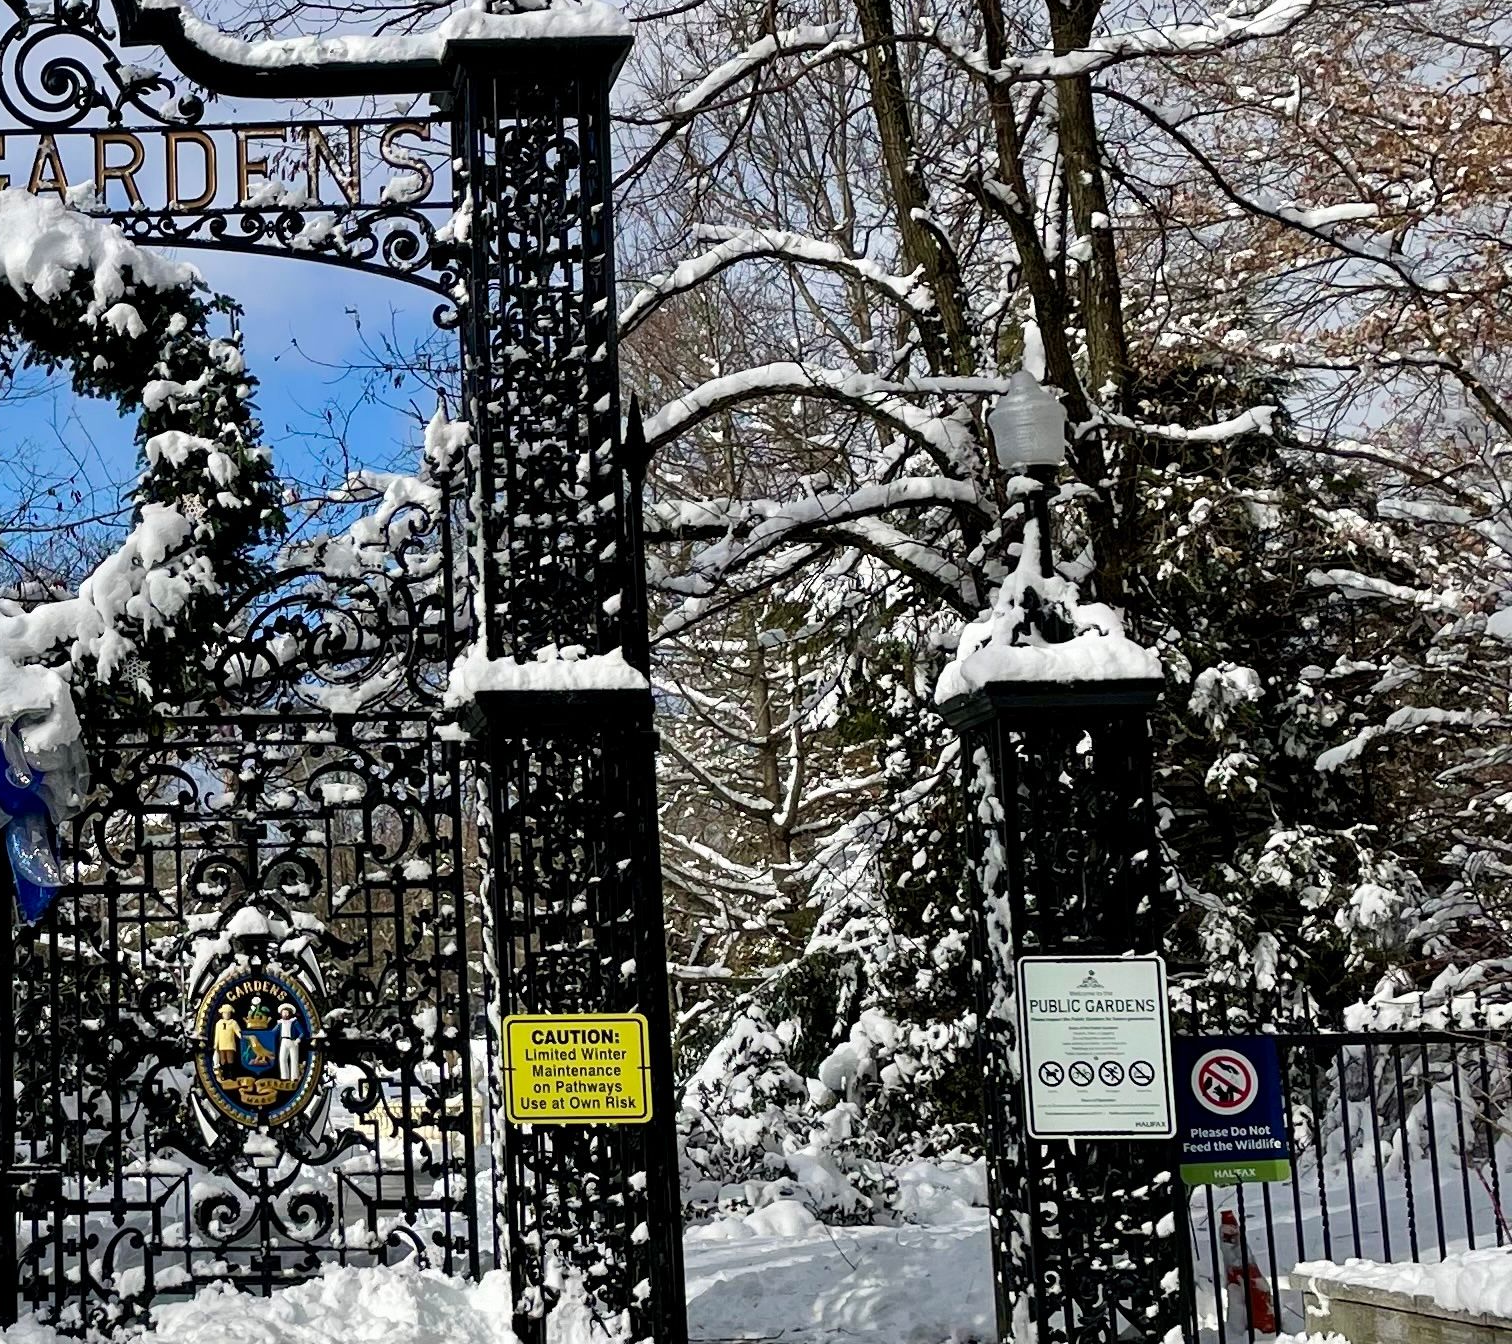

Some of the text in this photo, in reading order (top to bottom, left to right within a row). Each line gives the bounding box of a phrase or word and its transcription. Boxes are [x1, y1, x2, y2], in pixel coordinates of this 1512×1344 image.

[226, 980, 288, 1002] GARDENS
[1029, 999, 1155, 1013] PUBLIC GARDENS
[531, 1029, 620, 1045] CAUTION:
[525, 1048, 627, 1061] Limited Winter
[532, 1064, 621, 1077] Maintenance
[533, 1081, 623, 1095] on Pathways
[520, 1096, 637, 1110] Use at Own Risk
[1190, 1125, 1271, 1138] Please Do Not
[1183, 1137, 1282, 1153] Feed the Wildlife
